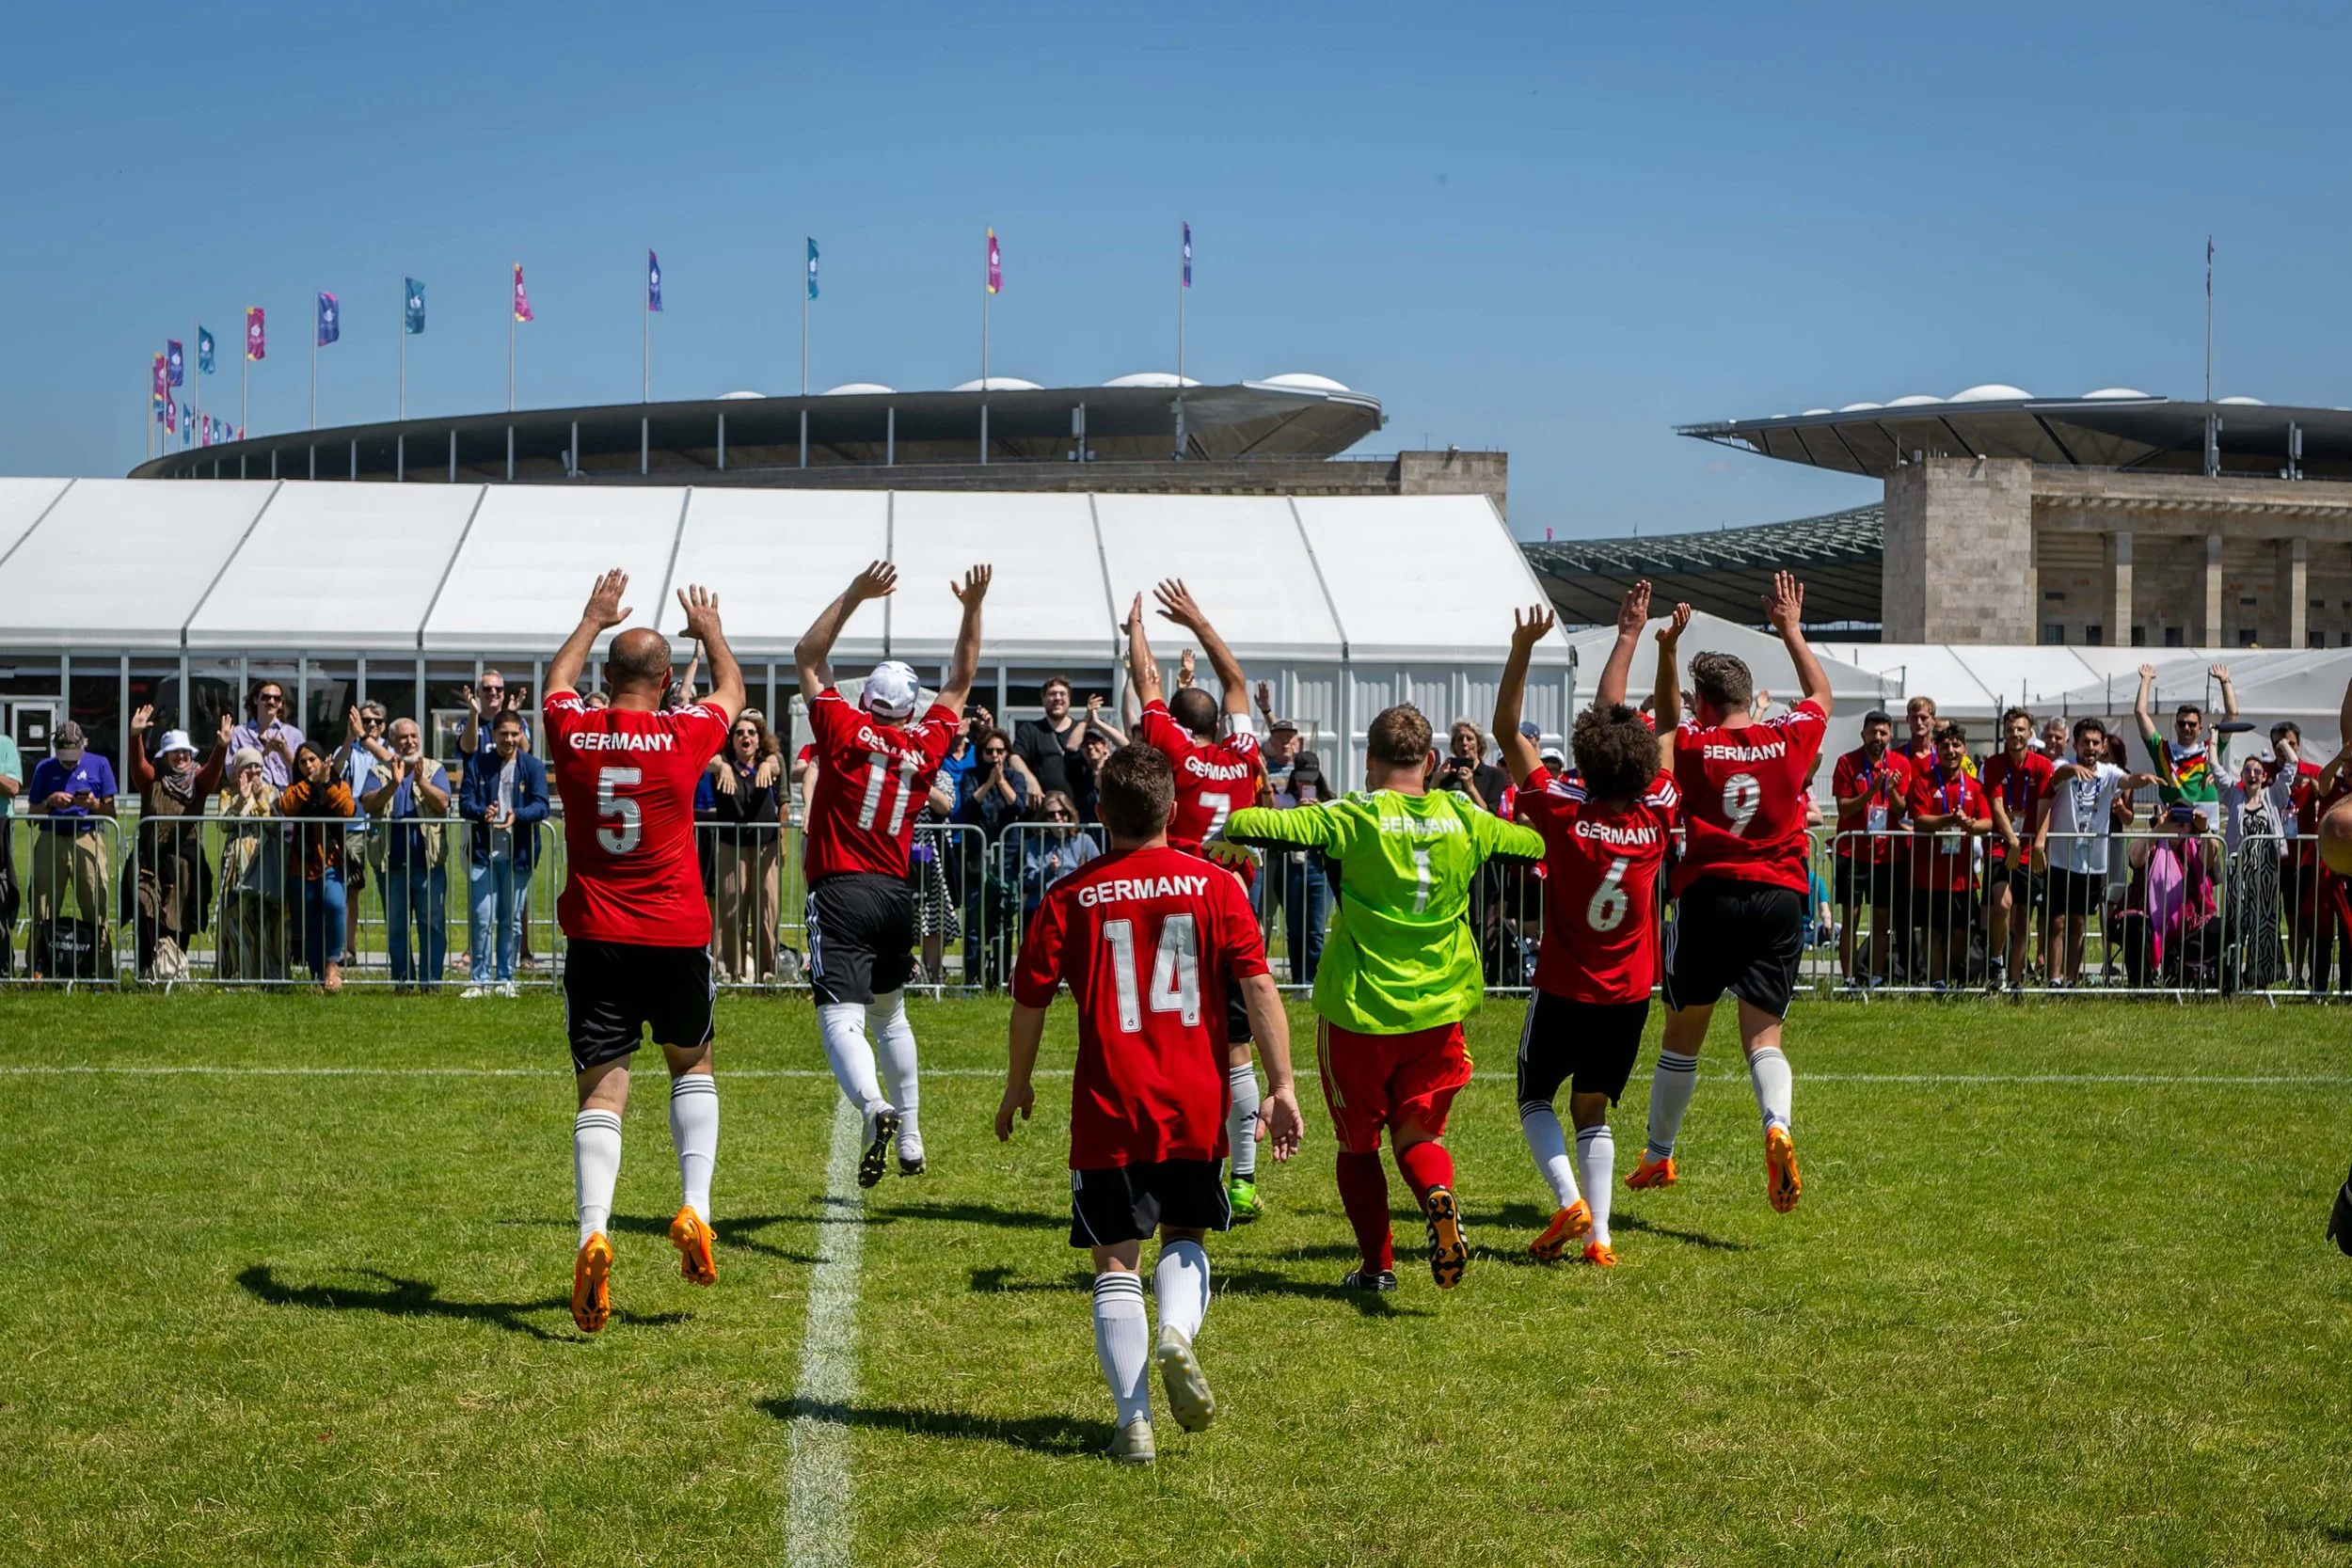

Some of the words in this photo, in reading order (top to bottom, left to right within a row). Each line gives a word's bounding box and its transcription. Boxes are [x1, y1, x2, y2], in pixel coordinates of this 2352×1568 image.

[569, 732, 674, 752] GERMANY
[1184, 755, 1248, 781] GERMANY
[1704, 741, 1786, 761] GERMANY
[596, 766, 642, 855] 5
[857, 751, 919, 836] 11
[1199, 791, 1231, 846] 7
[1723, 773, 1761, 837] 9
[1379, 816, 1464, 835] GERMANY
[1575, 820, 1658, 845] GERMANY
[1078, 876, 1208, 908] GERMANY
[1413, 848, 1431, 916] 1
[1587, 857, 1629, 932] 6
[1104, 913, 1200, 1033] 14
